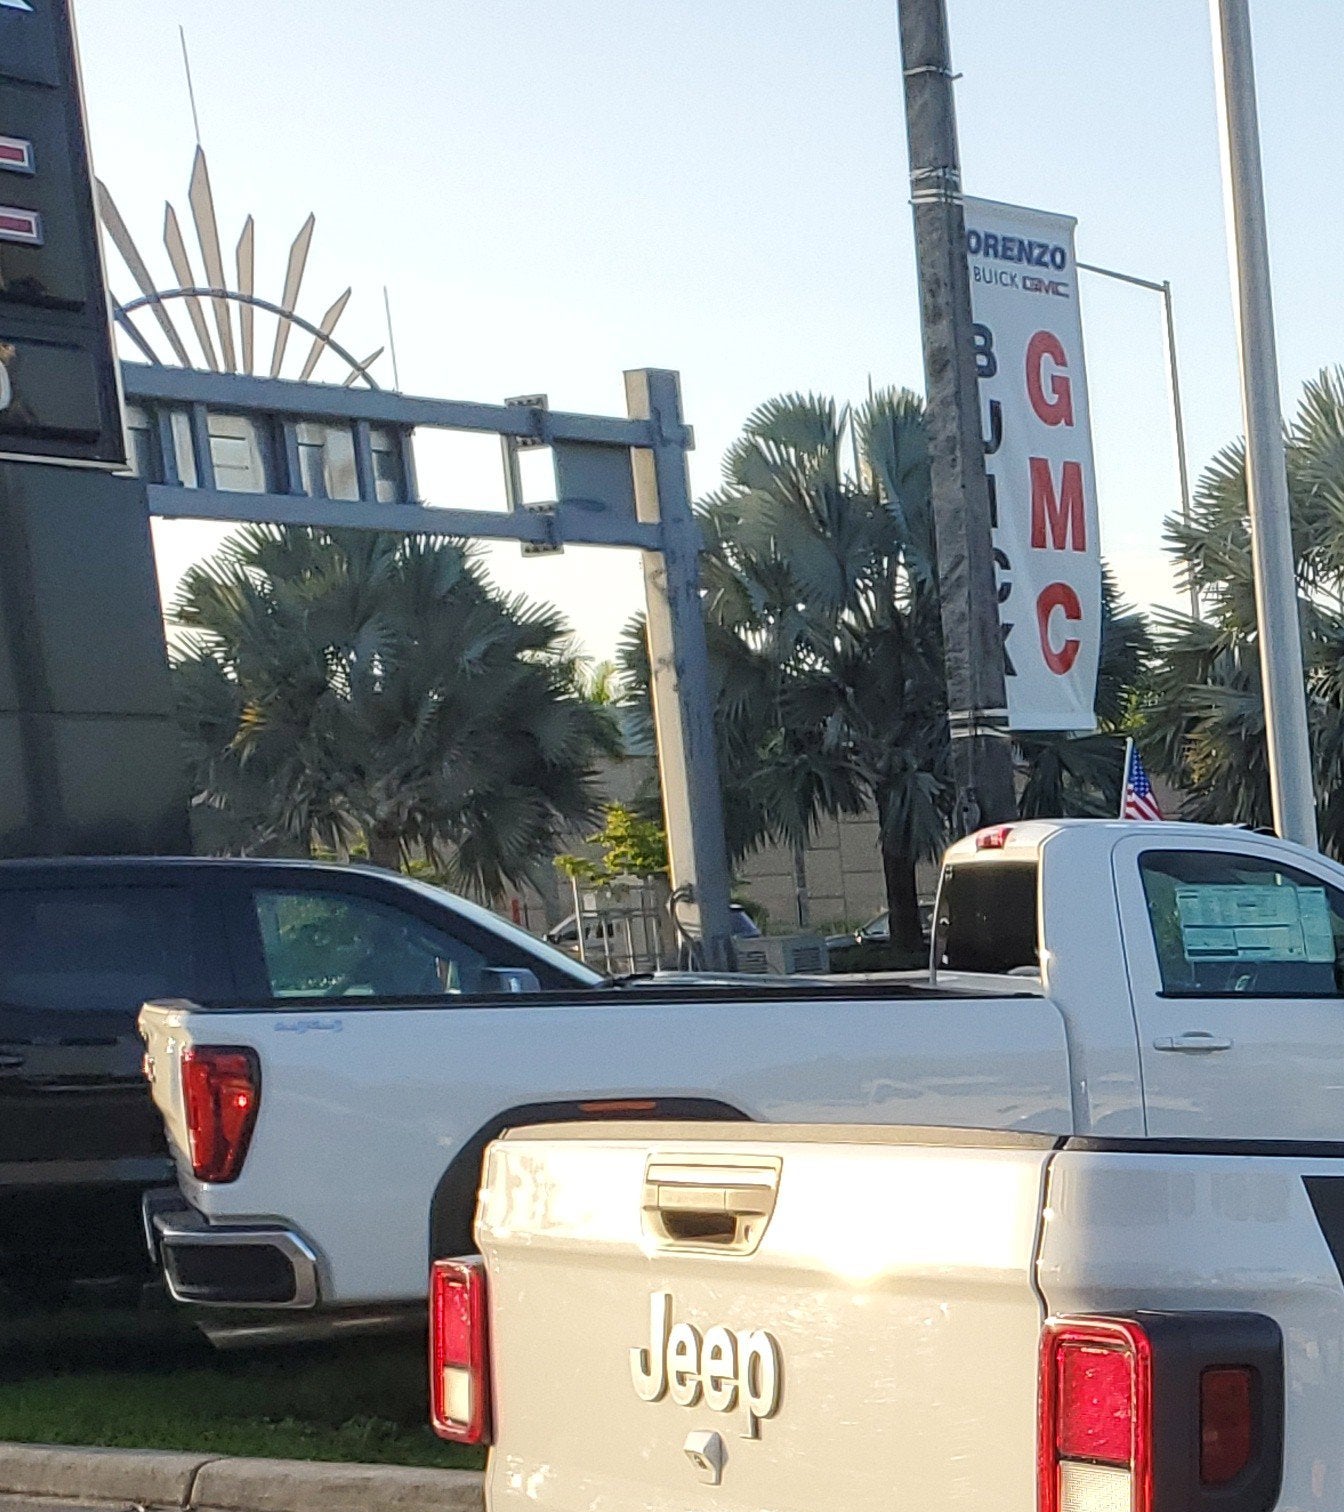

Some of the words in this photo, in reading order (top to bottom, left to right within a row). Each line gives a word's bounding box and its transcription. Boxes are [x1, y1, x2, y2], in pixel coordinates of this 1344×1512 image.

[973, 265, 1019, 290] BUICK
[1022, 275, 1070, 298] GMC
[1025, 330, 1087, 675] GMC
[629, 1290, 785, 1440] Jeep
